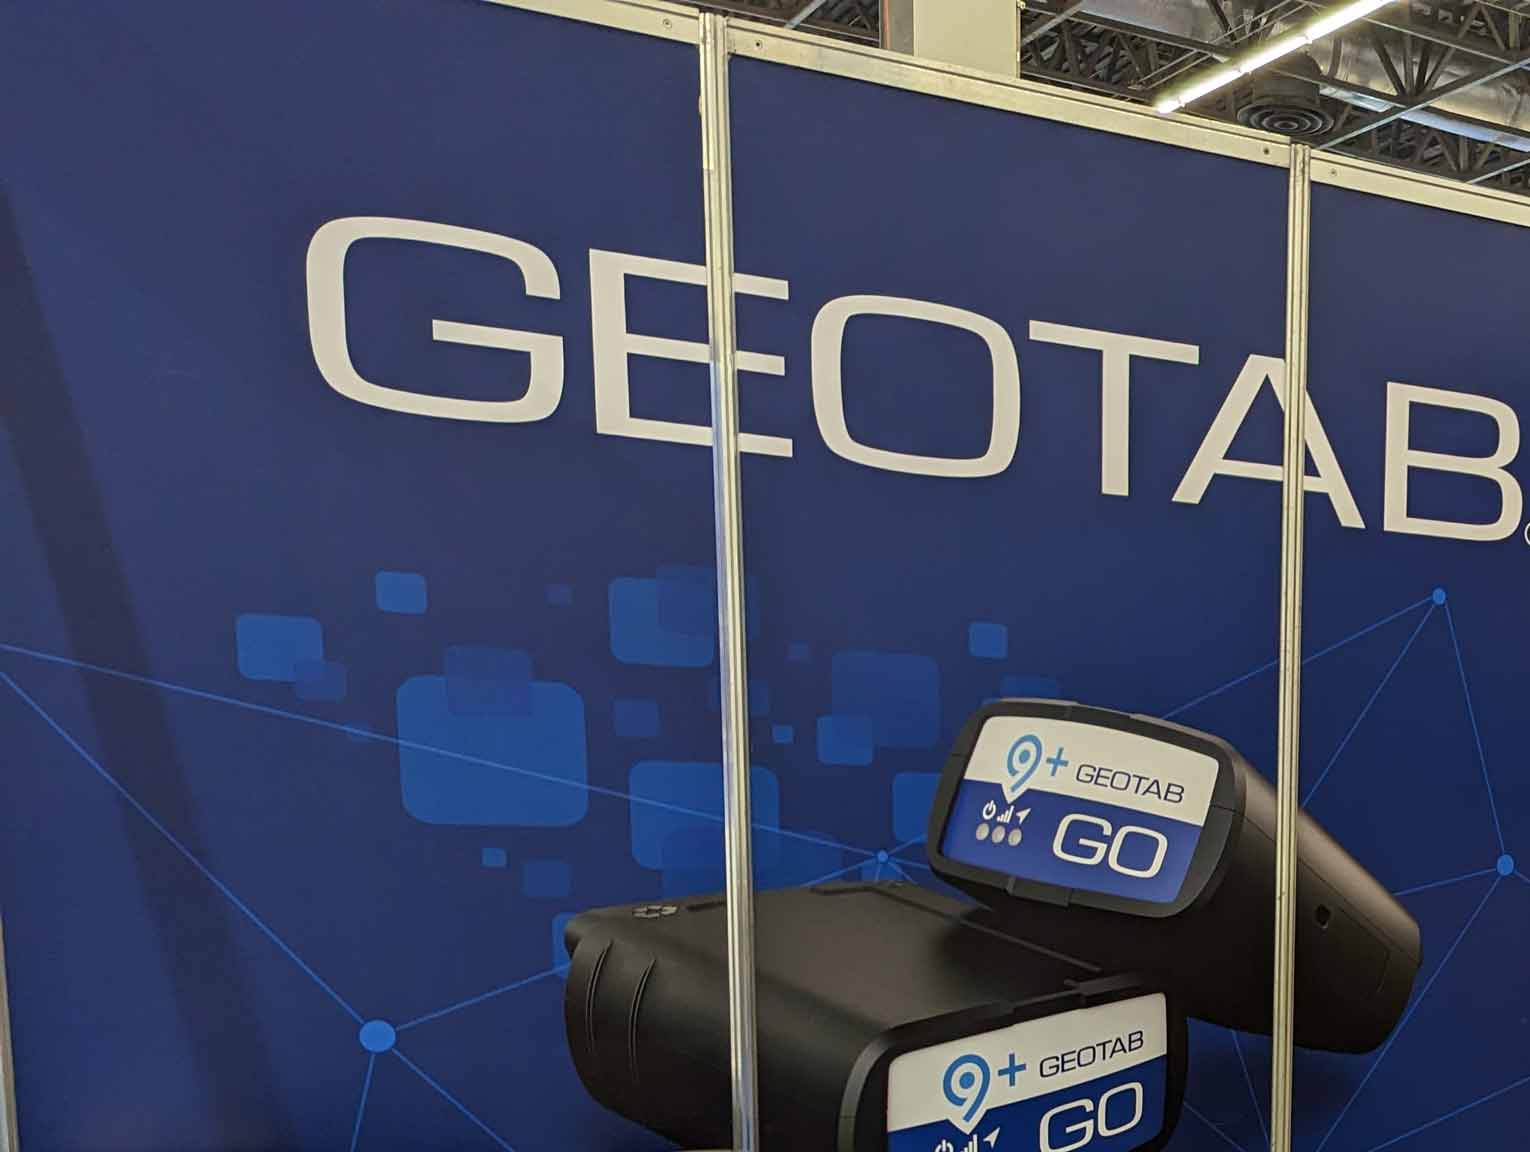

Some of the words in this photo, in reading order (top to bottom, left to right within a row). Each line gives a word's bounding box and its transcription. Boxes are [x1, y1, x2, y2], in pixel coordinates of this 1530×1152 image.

[1075, 763, 1185, 804] GEOTAB
[1052, 812, 1169, 879] GO
[1039, 1030, 1145, 1079] GEOTAB
